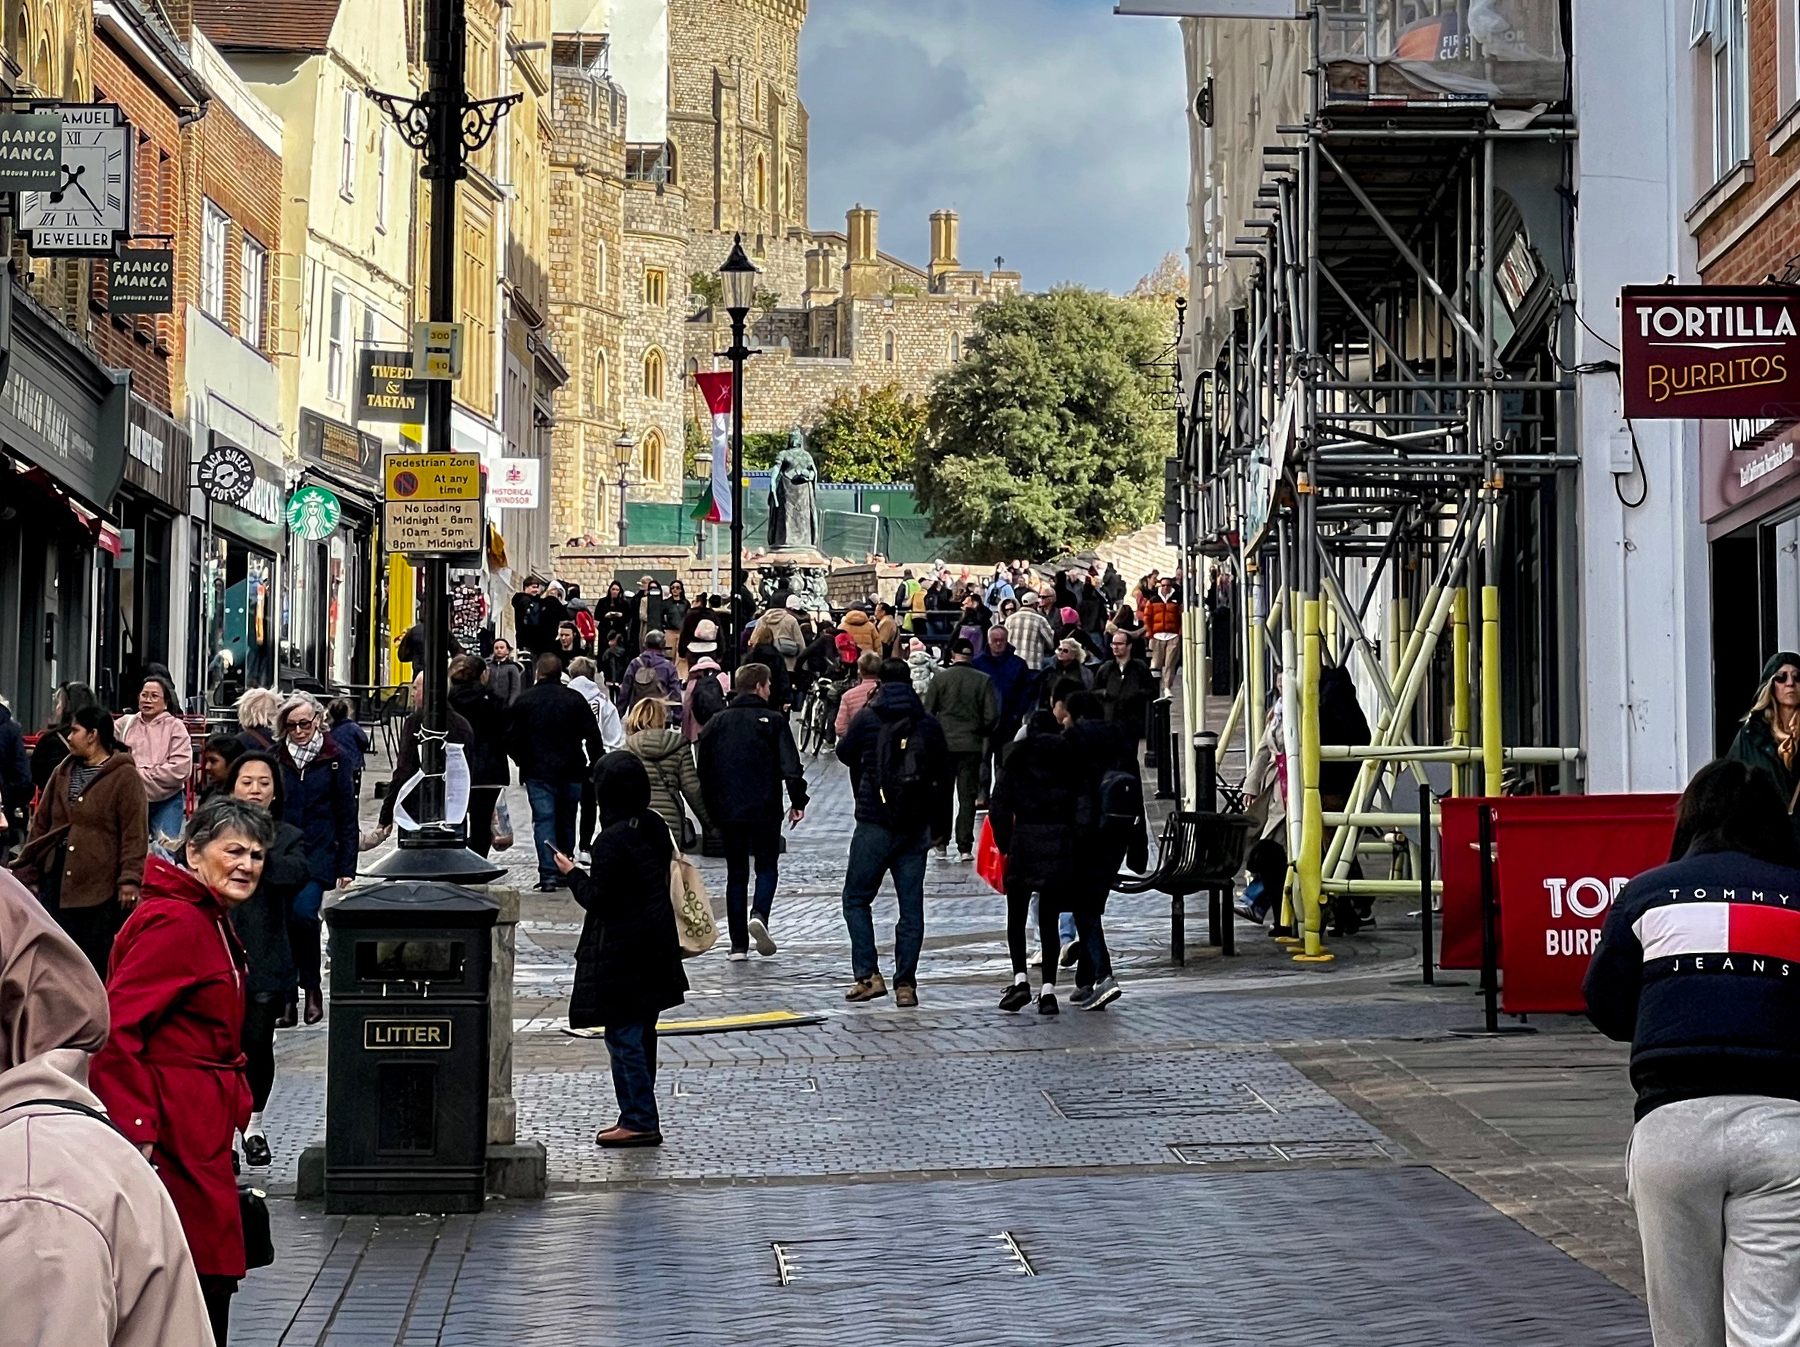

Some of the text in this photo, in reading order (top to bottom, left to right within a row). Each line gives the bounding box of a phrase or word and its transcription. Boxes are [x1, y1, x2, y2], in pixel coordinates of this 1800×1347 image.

[37, 232, 108, 246] JEWELLER
[112, 261, 169, 273] FRANCO
[114, 274, 168, 288] MANCA
[1636, 306, 1797, 337] TORTILLA
[430, 331, 450, 340] 300
[370, 365, 413, 379] TWEED
[1647, 354, 1788, 402] BURRITOS
[385, 380, 400, 394] &
[366, 394, 416, 409] TARTAN
[201, 449, 251, 479] BLACK SHEEP
[389, 458, 475, 468] Pedestrian Zone
[434, 474, 468, 485] At any
[210, 481, 249, 501] COFFEE
[439, 486, 463, 495] time
[491, 488, 533, 496] HISTORICAL
[404, 504, 461, 514] No loading
[393, 516, 439, 526] Midnight
[450, 515, 473, 524] 6am
[401, 527, 430, 536] 10am
[441, 527, 464, 538] 5pm
[392, 539, 416, 550] 8pm
[427, 538, 474, 549] Midnight
[1668, 888, 1790, 905] TOMMY
[1672, 957, 1790, 977] JEANS
[375, 1027, 441, 1043] LITTER
